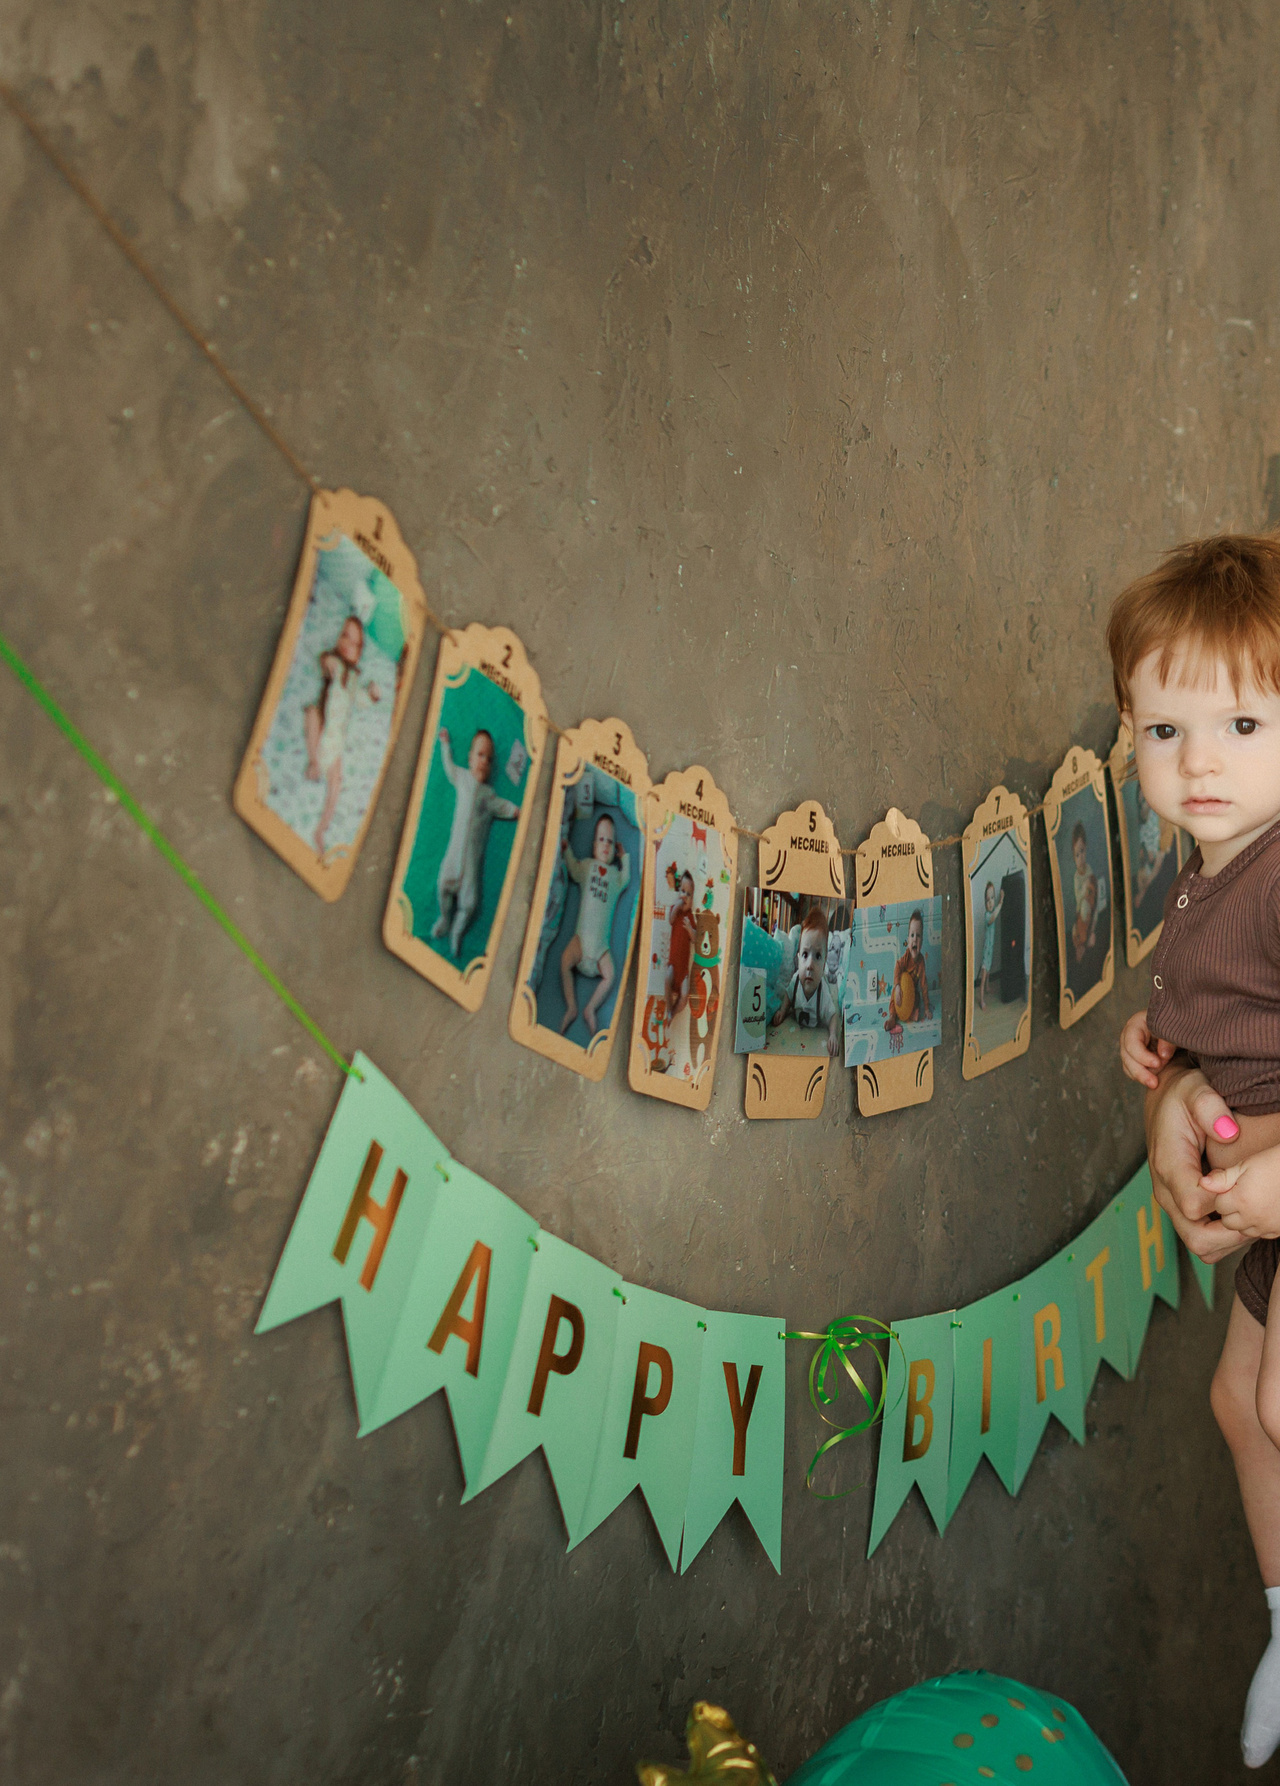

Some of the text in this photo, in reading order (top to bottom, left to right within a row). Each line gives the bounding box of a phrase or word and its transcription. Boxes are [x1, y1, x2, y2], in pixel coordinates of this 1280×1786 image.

[372, 516, 384, 541] 1
[501, 644, 513, 669] 2
[613, 732, 623, 757] 3
[593, 751, 633, 787] МЕСЯЦА
[1072, 756, 1078, 774] 8
[695, 779, 704, 801] 4
[679, 800, 716, 828] МЕСЯЦА
[994, 795, 1001, 815] 7
[808, 811, 817, 833] 5
[983, 815, 1014, 837] МЕСЯЦЕВ
[790, 836, 830, 854] МЕСЯЦЕВ
[881, 842, 916, 858] МЕСЯЦЕВ
[752, 984, 762, 1012] 5
[331, 1139, 1166, 1477] HAPPY BIRTH
